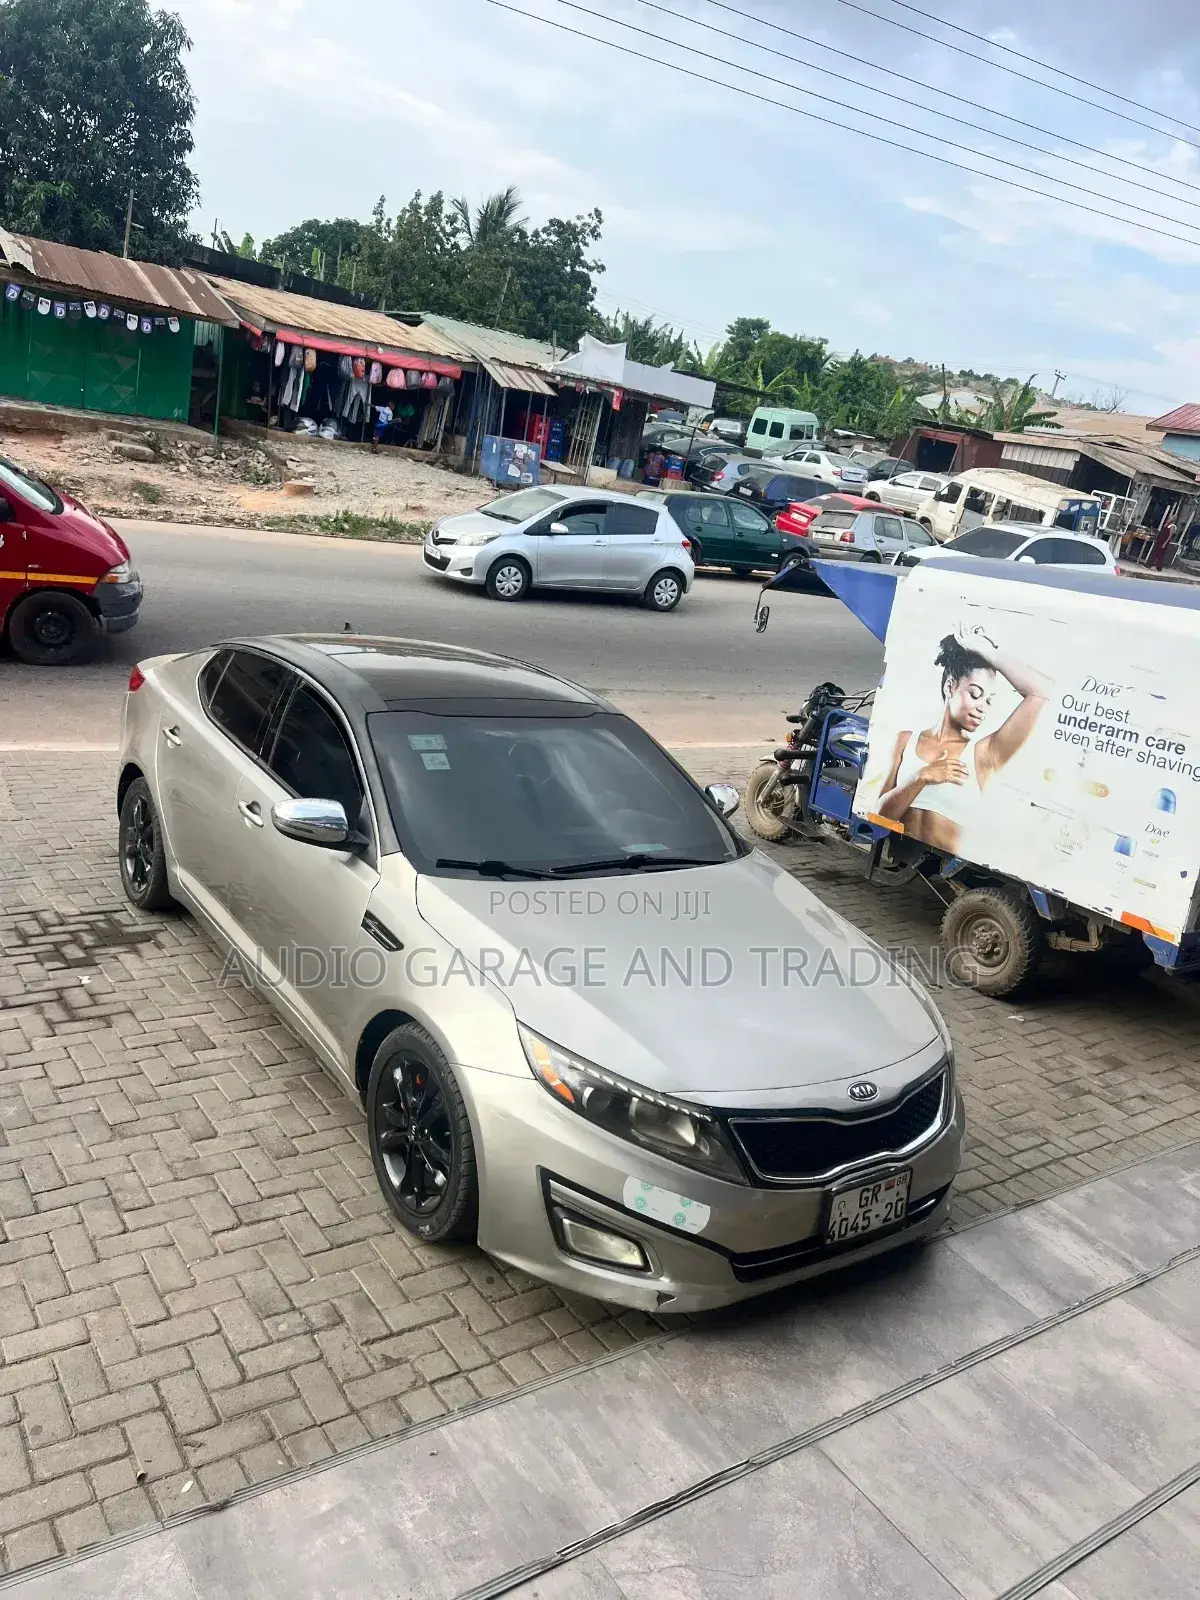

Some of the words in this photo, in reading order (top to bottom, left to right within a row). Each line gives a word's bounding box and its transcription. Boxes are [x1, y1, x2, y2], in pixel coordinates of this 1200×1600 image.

[1081, 676, 1121, 698] Dove
[1062, 694, 1091, 713] Our
[1094, 702, 1131, 724] best
[1054, 728, 1090, 748] even
[1095, 739, 1133, 758] after
[1057, 713, 1140, 744] underarm
[1144, 735, 1186, 755] care
[1144, 821, 1170, 838] Dove
[852, 1084, 876, 1097] KIA
[859, 1185, 882, 1208] GR
[827, 1198, 904, 1241] 4045-20
